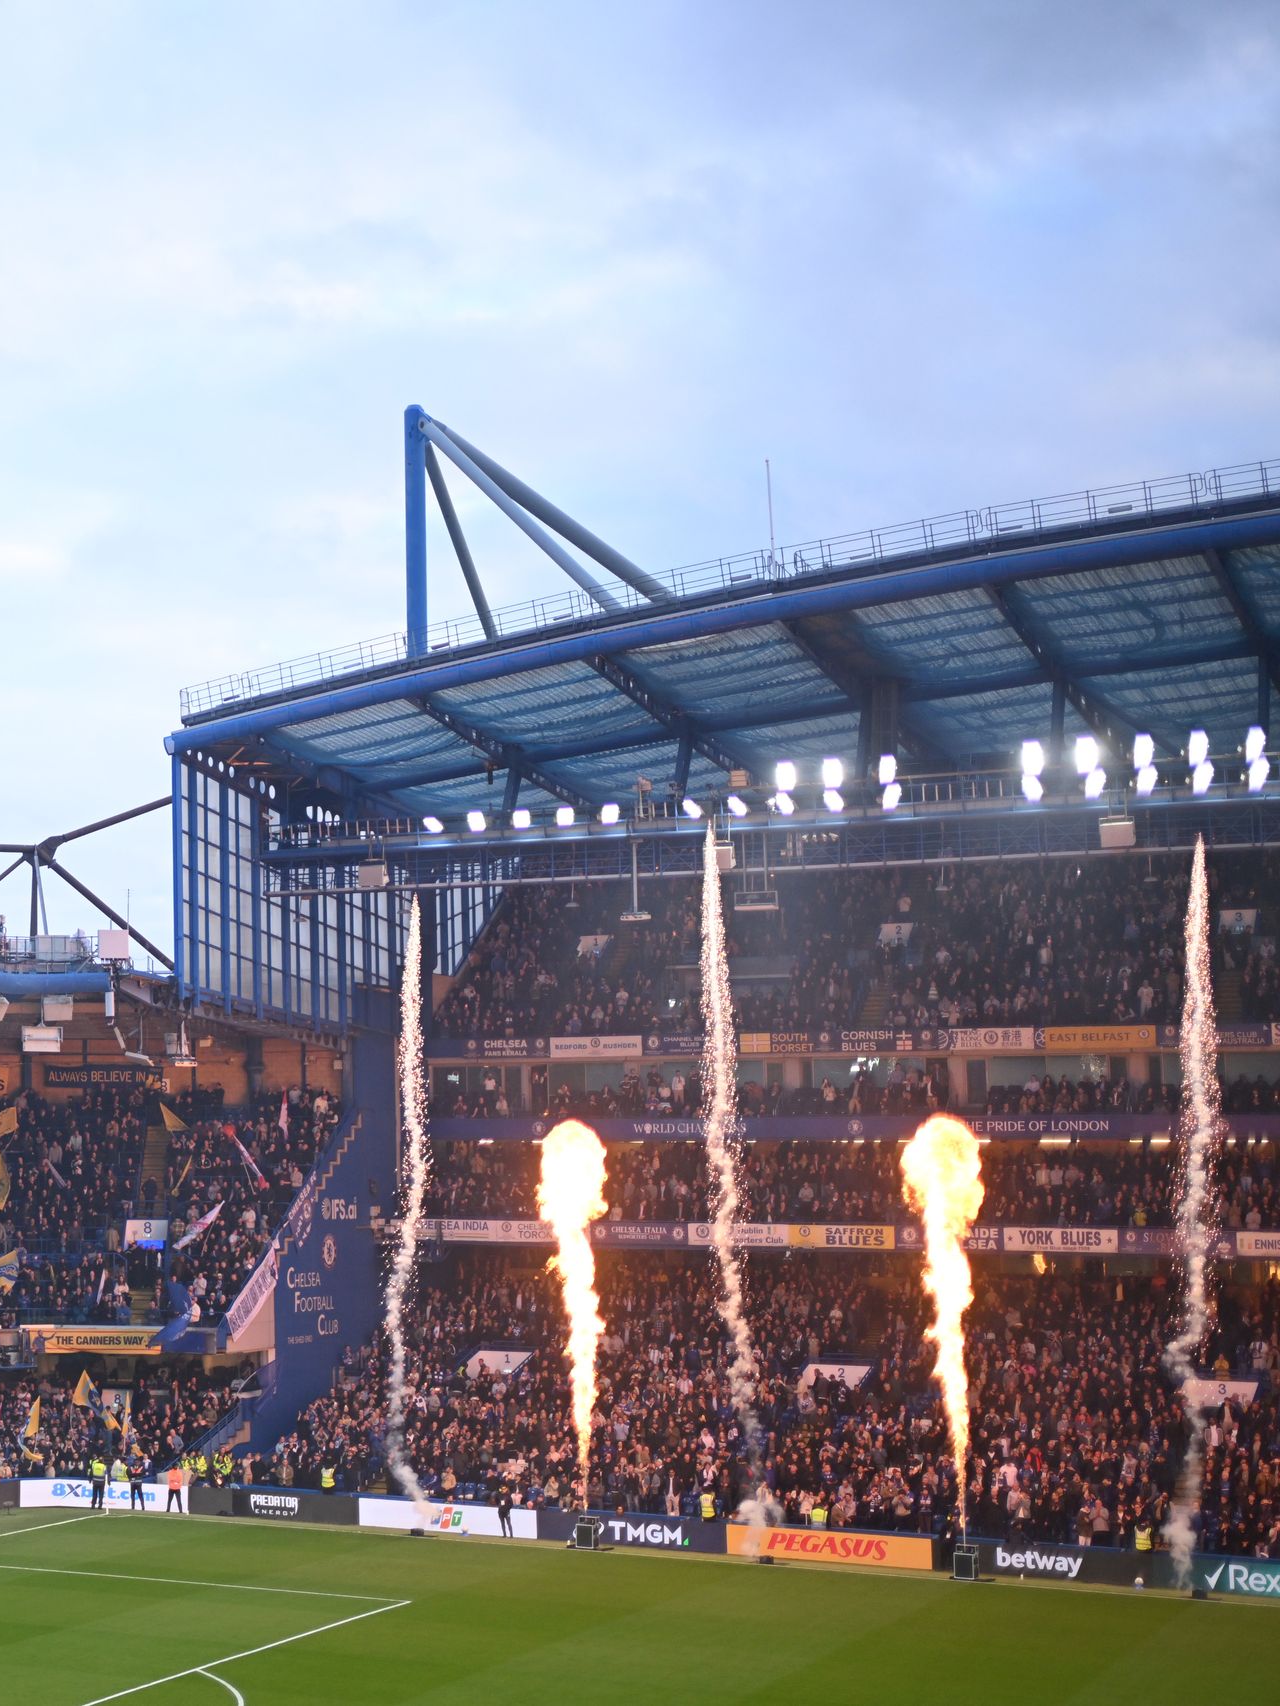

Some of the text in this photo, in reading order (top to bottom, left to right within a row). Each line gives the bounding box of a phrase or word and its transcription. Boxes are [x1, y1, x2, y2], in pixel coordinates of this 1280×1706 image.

[771, 1033, 808, 1042] SOUTH
[841, 1030, 893, 1040] CORNISH
[1049, 1031, 1131, 1042] EAST BELFAST
[483, 1040, 528, 1049] CHELSEA
[771, 1043, 814, 1052] DORSET
[841, 1042, 877, 1051] BLUES
[48, 1071, 88, 1083] ALWAYS
[91, 1071, 133, 1083] BELIEVE
[135, 1071, 146, 1082] IN
[633, 1122, 747, 1134] WORLD CHANS
[986, 1120, 1026, 1131] PRIDE
[1028, 1120, 1048, 1131] OF
[1051, 1120, 1109, 1131] LONDON
[331, 1196, 357, 1220] IFS.ai
[144, 1221, 152, 1233] 8
[423, 1220, 489, 1231] ELSEA INDIA
[517, 1223, 553, 1231] CHELS
[611, 1225, 667, 1234] CHELSEA ITALIA
[517, 1230, 553, 1239] TORON
[825, 1227, 884, 1236] SAFFRON
[765, 1236, 784, 1244] Club
[825, 1235, 885, 1246] BLUES
[1019, 1230, 1102, 1247] YORK BLUES
[55, 1335, 145, 1346] THE CANNERS WAY
[505, 1354, 511, 1364] 1
[837, 1368, 846, 1378] 2
[1217, 1383, 1227, 1395] 3
[51, 1483, 156, 1502] 8Xbt.cm
[250, 1493, 299, 1510] PREDATOR
[255, 1508, 296, 1516] ENERGY
[430, 1506, 463, 1529] PT
[608, 1520, 682, 1545] TMGM
[767, 1532, 889, 1561] PEGASUS
[996, 1547, 1083, 1577] betway
[1228, 1564, 1280, 1593] Rex
